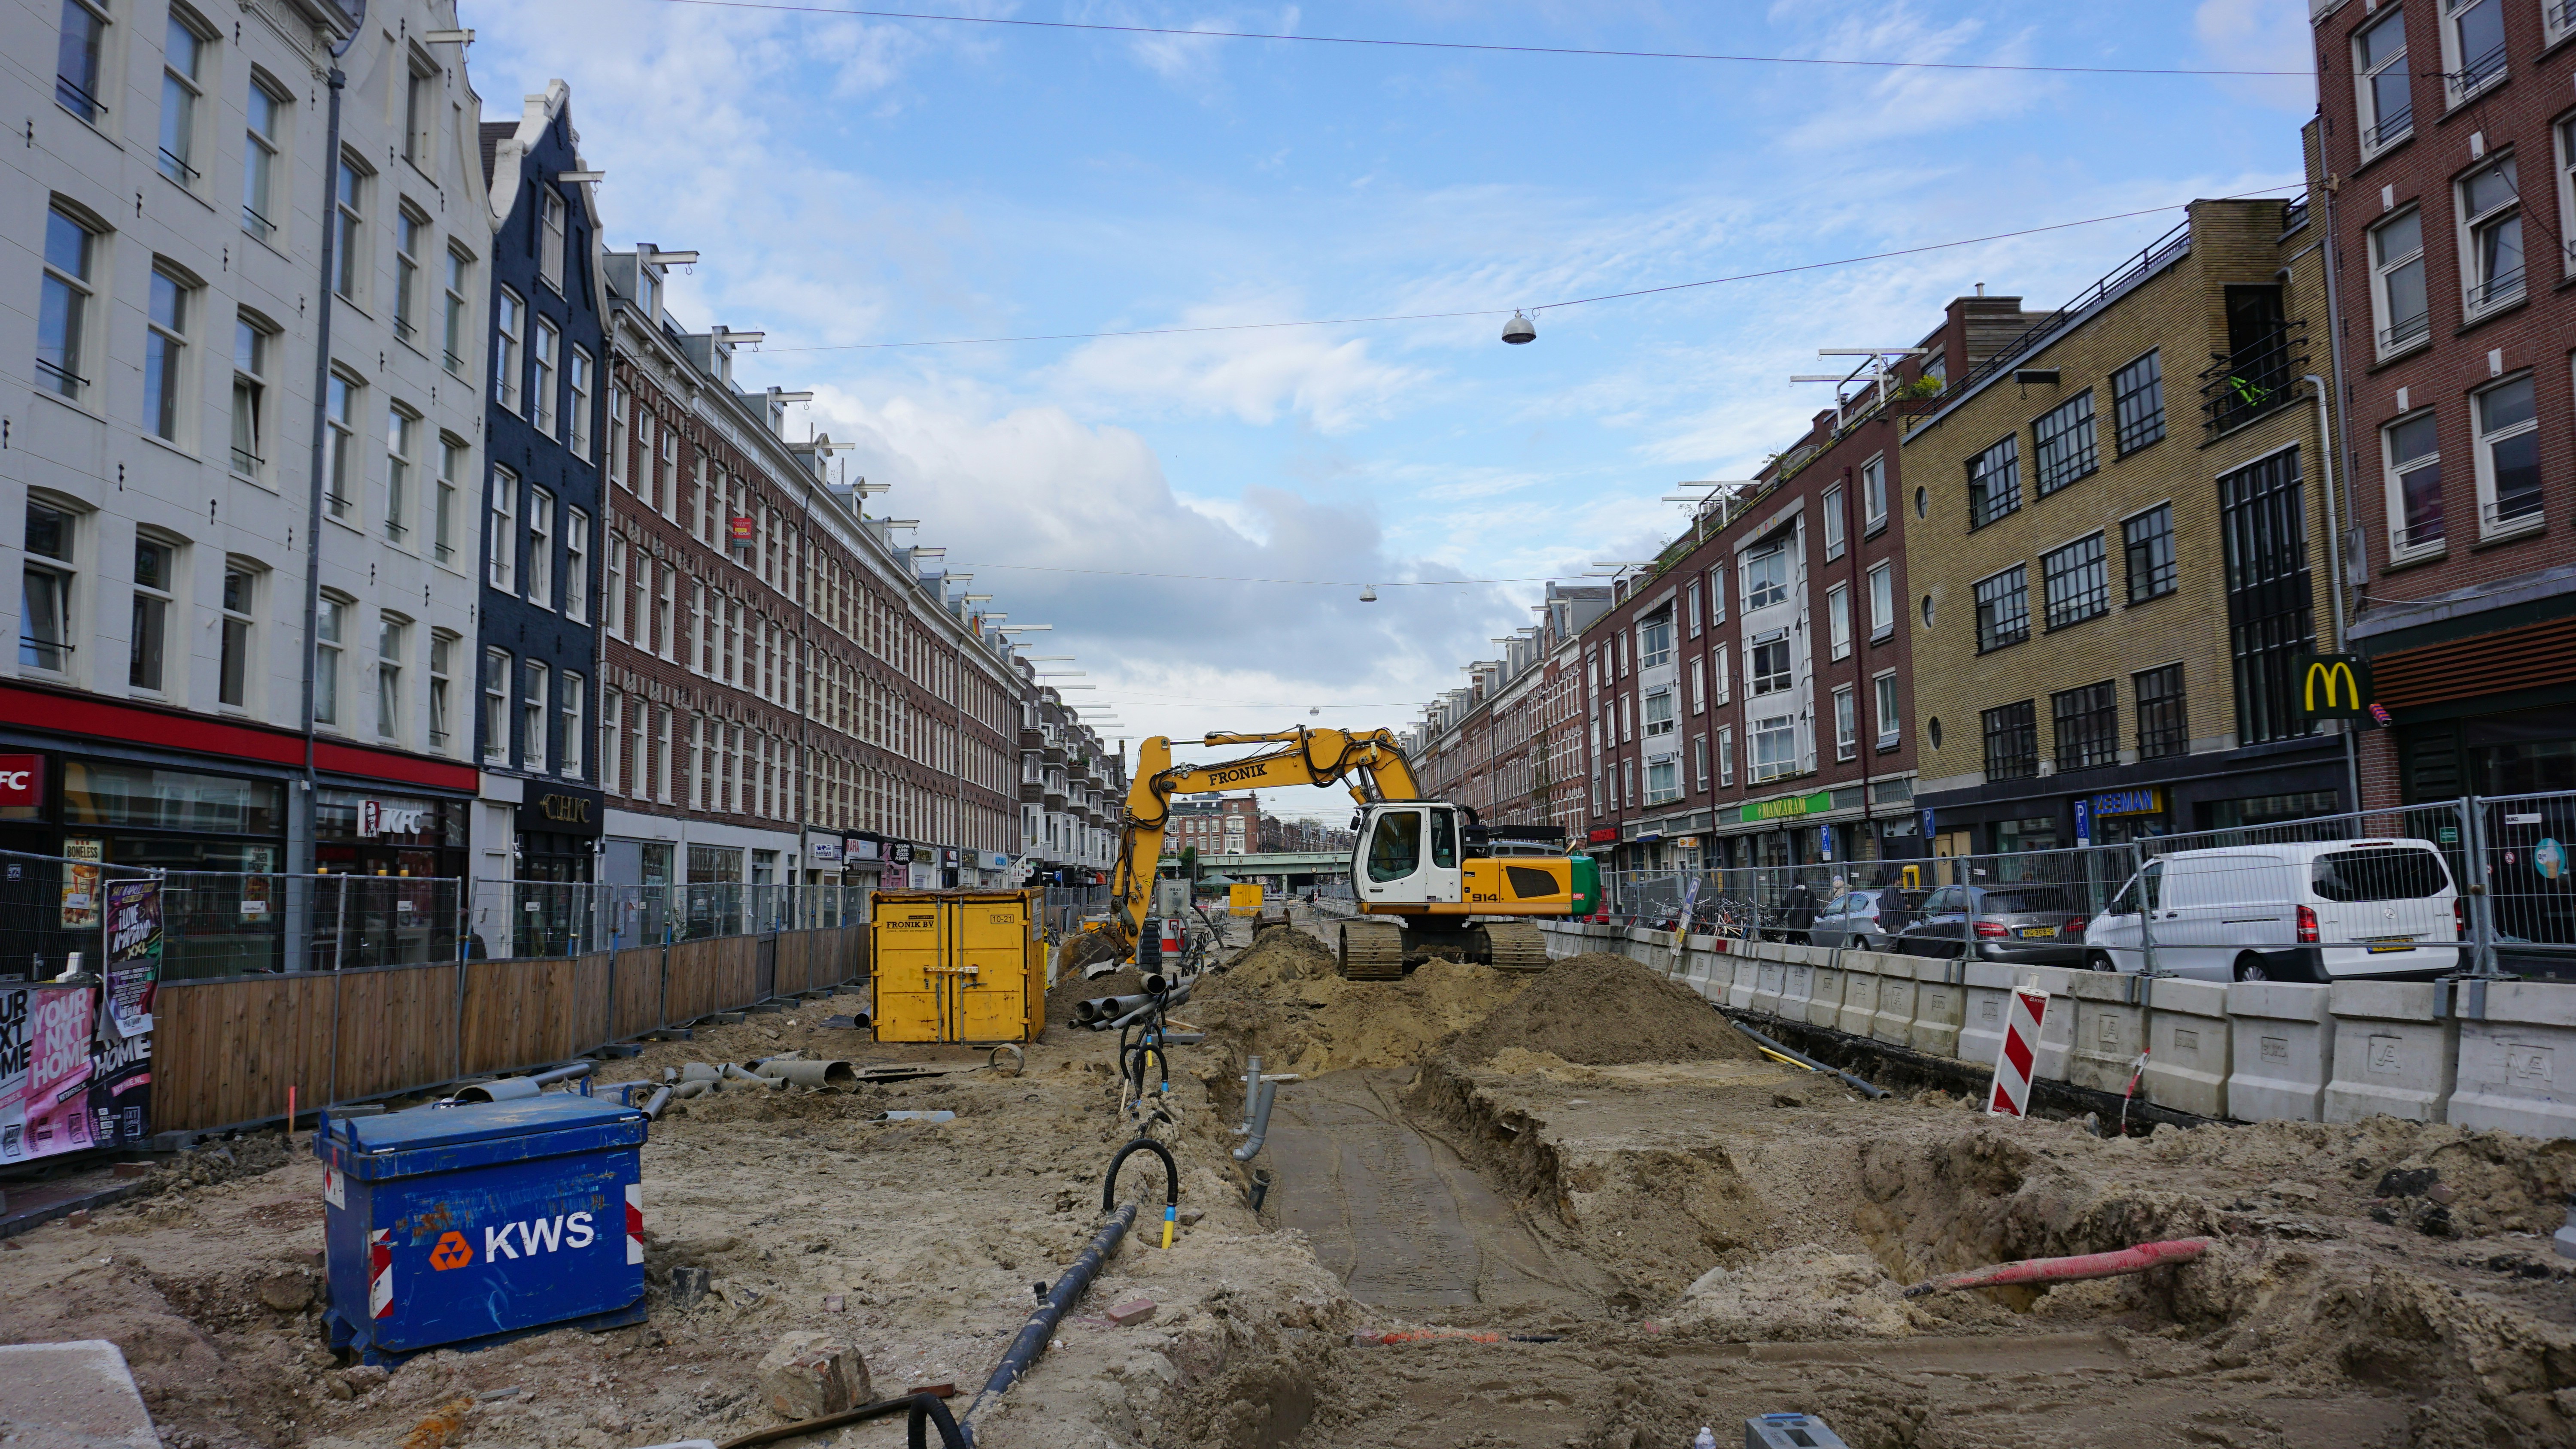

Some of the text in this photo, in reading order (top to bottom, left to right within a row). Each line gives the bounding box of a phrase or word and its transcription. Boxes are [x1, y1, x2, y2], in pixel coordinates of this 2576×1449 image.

[1208, 763, 1267, 786] FRONIK
[542, 793, 591, 824] CHIC
[1762, 798, 1807, 818] MANZARAM
[2093, 789, 2154, 815] ZEEMAN
[389, 808, 423, 834] KFC
[1925, 810, 1931, 827] P
[2078, 805, 2084, 823] P
[1823, 828, 1828, 840] P
[67, 846, 98, 858] BONELESS
[1472, 894, 1498, 902] 914
[1688, 881, 1698, 899] P
[128, 941, 148, 960] XXL
[34, 988, 88, 1034] YOUR
[46, 1012, 86, 1056] NXT
[33, 1034, 92, 1089] HOME
[93, 1033, 151, 1081] HOME
[485, 1211, 594, 1263] KWS
